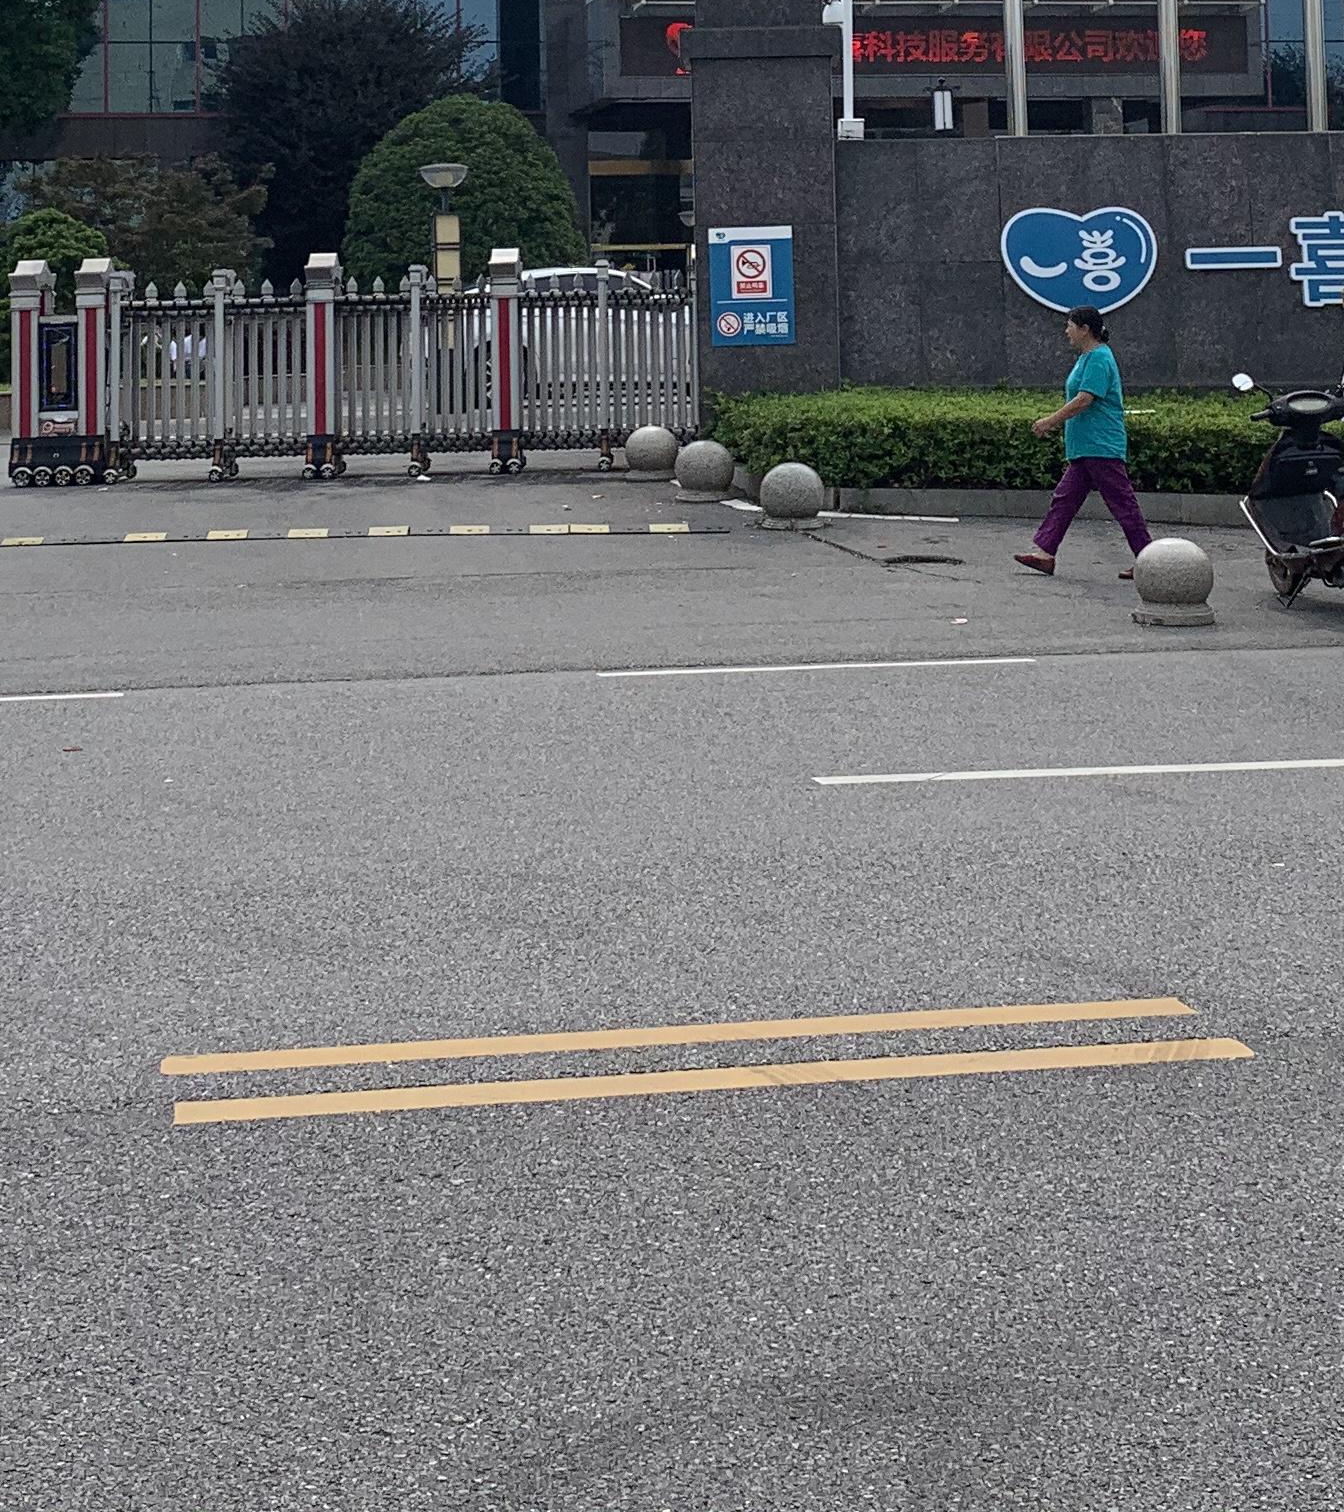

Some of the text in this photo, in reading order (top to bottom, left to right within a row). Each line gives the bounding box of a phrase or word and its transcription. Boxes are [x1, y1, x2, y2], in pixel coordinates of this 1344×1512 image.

[743, 311, 788, 323] 进入厂区
[743, 322, 789, 335] 严禁吸烟
